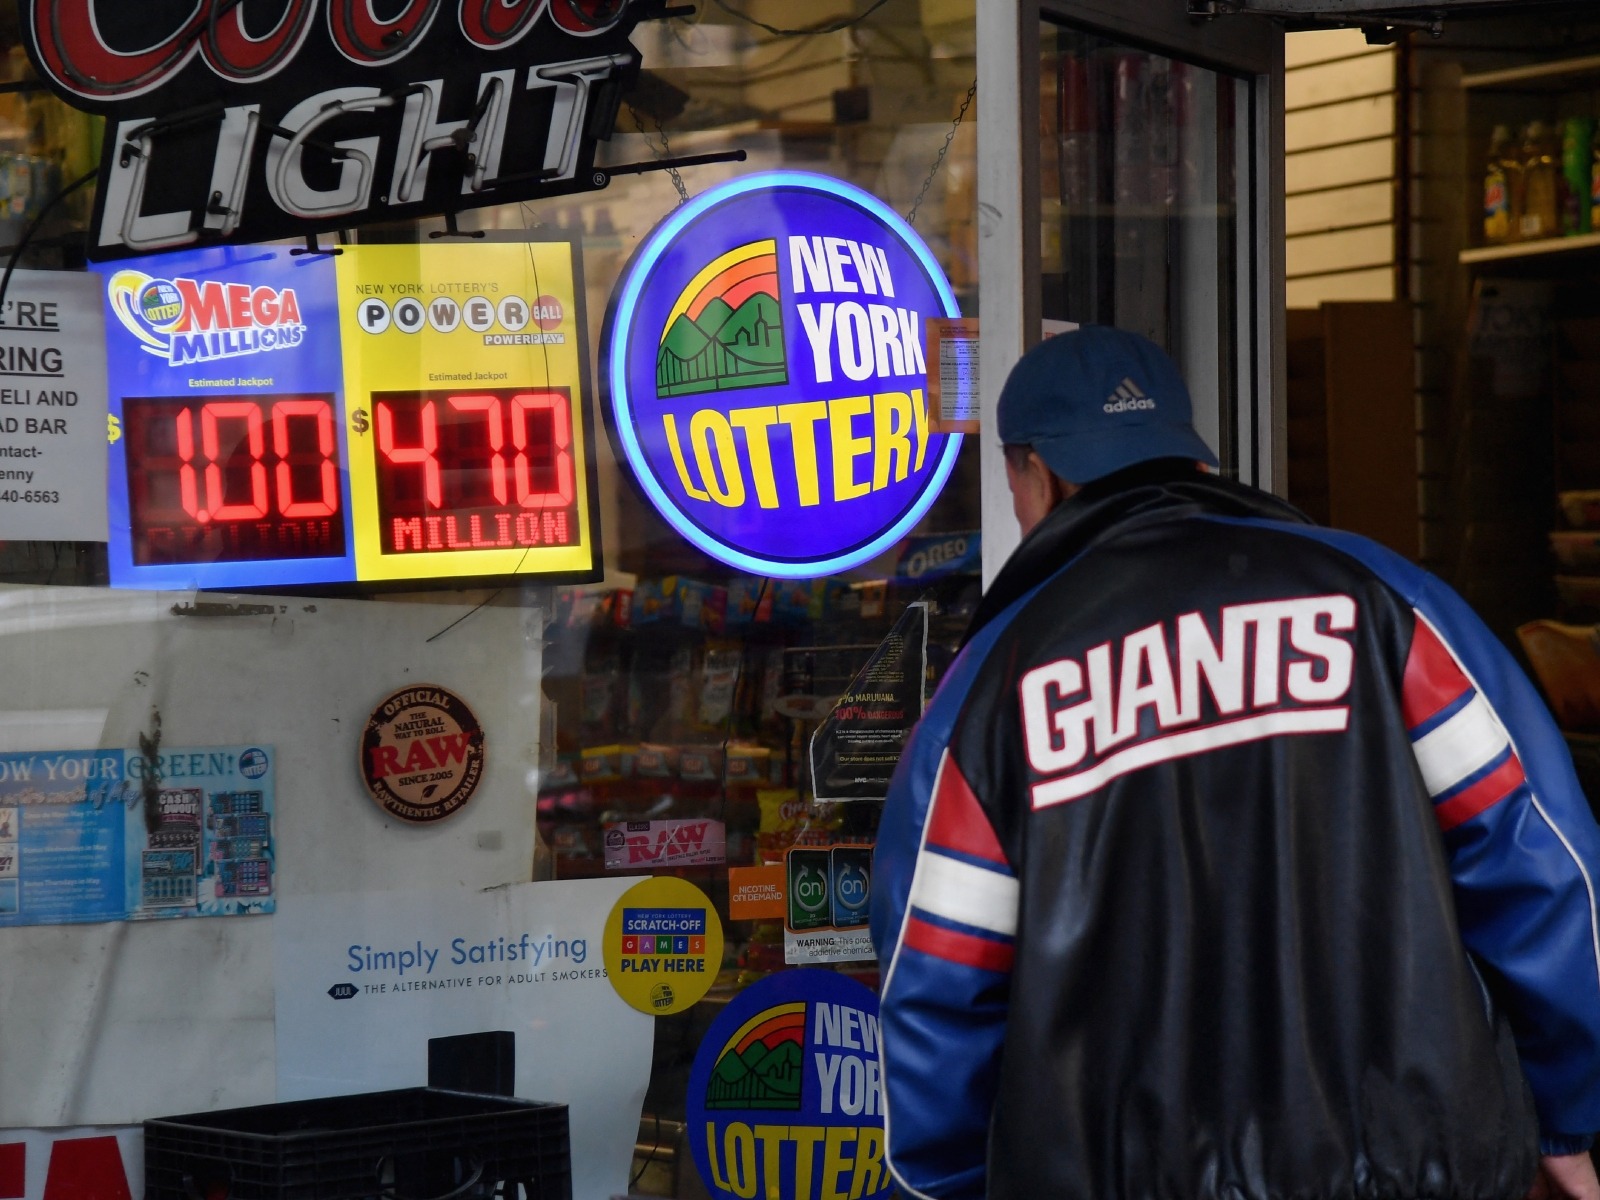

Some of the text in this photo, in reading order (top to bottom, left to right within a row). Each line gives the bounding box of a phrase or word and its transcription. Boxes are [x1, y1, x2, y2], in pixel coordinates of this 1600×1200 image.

[98, 53, 633, 251] LIGHT
[788, 235, 895, 298] NEW
[355, 282, 499, 295] NEW YORK LOTTERY'S
[0, 301, 58, 327] 'RE
[173, 279, 301, 333] MEGA
[172, 326, 302, 363] MILLIONS
[796, 300, 927, 384] YORK
[188, 377, 274, 388] Estimated Jackpot
[428, 371, 508, 382] Estimated Jackpot
[37, 391, 78, 407] AND
[1103, 397, 1155, 414] adidas
[25, 418, 67, 434] BAR
[351, 394, 573, 509] $ 470
[662, 388, 931, 509] LOTTERY
[393, 511, 568, 550] MILLION
[907, 538, 967, 578] OREO
[1018, 594, 1357, 773] GIANTS
[383, 690, 450, 716] OFFICIAL
[409, 711, 427, 720] THE
[393, 731, 411, 740] WAY
[425, 726, 446, 735] ROLL
[394, 716, 444, 732] NATURAL
[43, 754, 118, 781] YOUR
[370, 731, 472, 779] RAW
[398, 770, 453, 787] SINCE 2005
[444, 759, 480, 811] RETAILER
[158, 794, 189, 804] CASH
[159, 804, 197, 814] OWOUT
[626, 822, 708, 864] RAW
[739, 885, 775, 894] NICOTINE
[748, 892, 782, 902] DEMAND
[627, 919, 701, 931] SCRATCH-OFF
[347, 933, 587, 976] Simply Satisfying
[621, 958, 705, 973] PLAY HERE
[808, 949, 841, 957] addictive
[364, 967, 608, 995] THE ALTERNATIVE FOR ADULT SMOKERS
[814, 1001, 883, 1053] NEW
[814, 1052, 885, 1116] YOR
[706, 1121, 892, 1200] LOTTER
